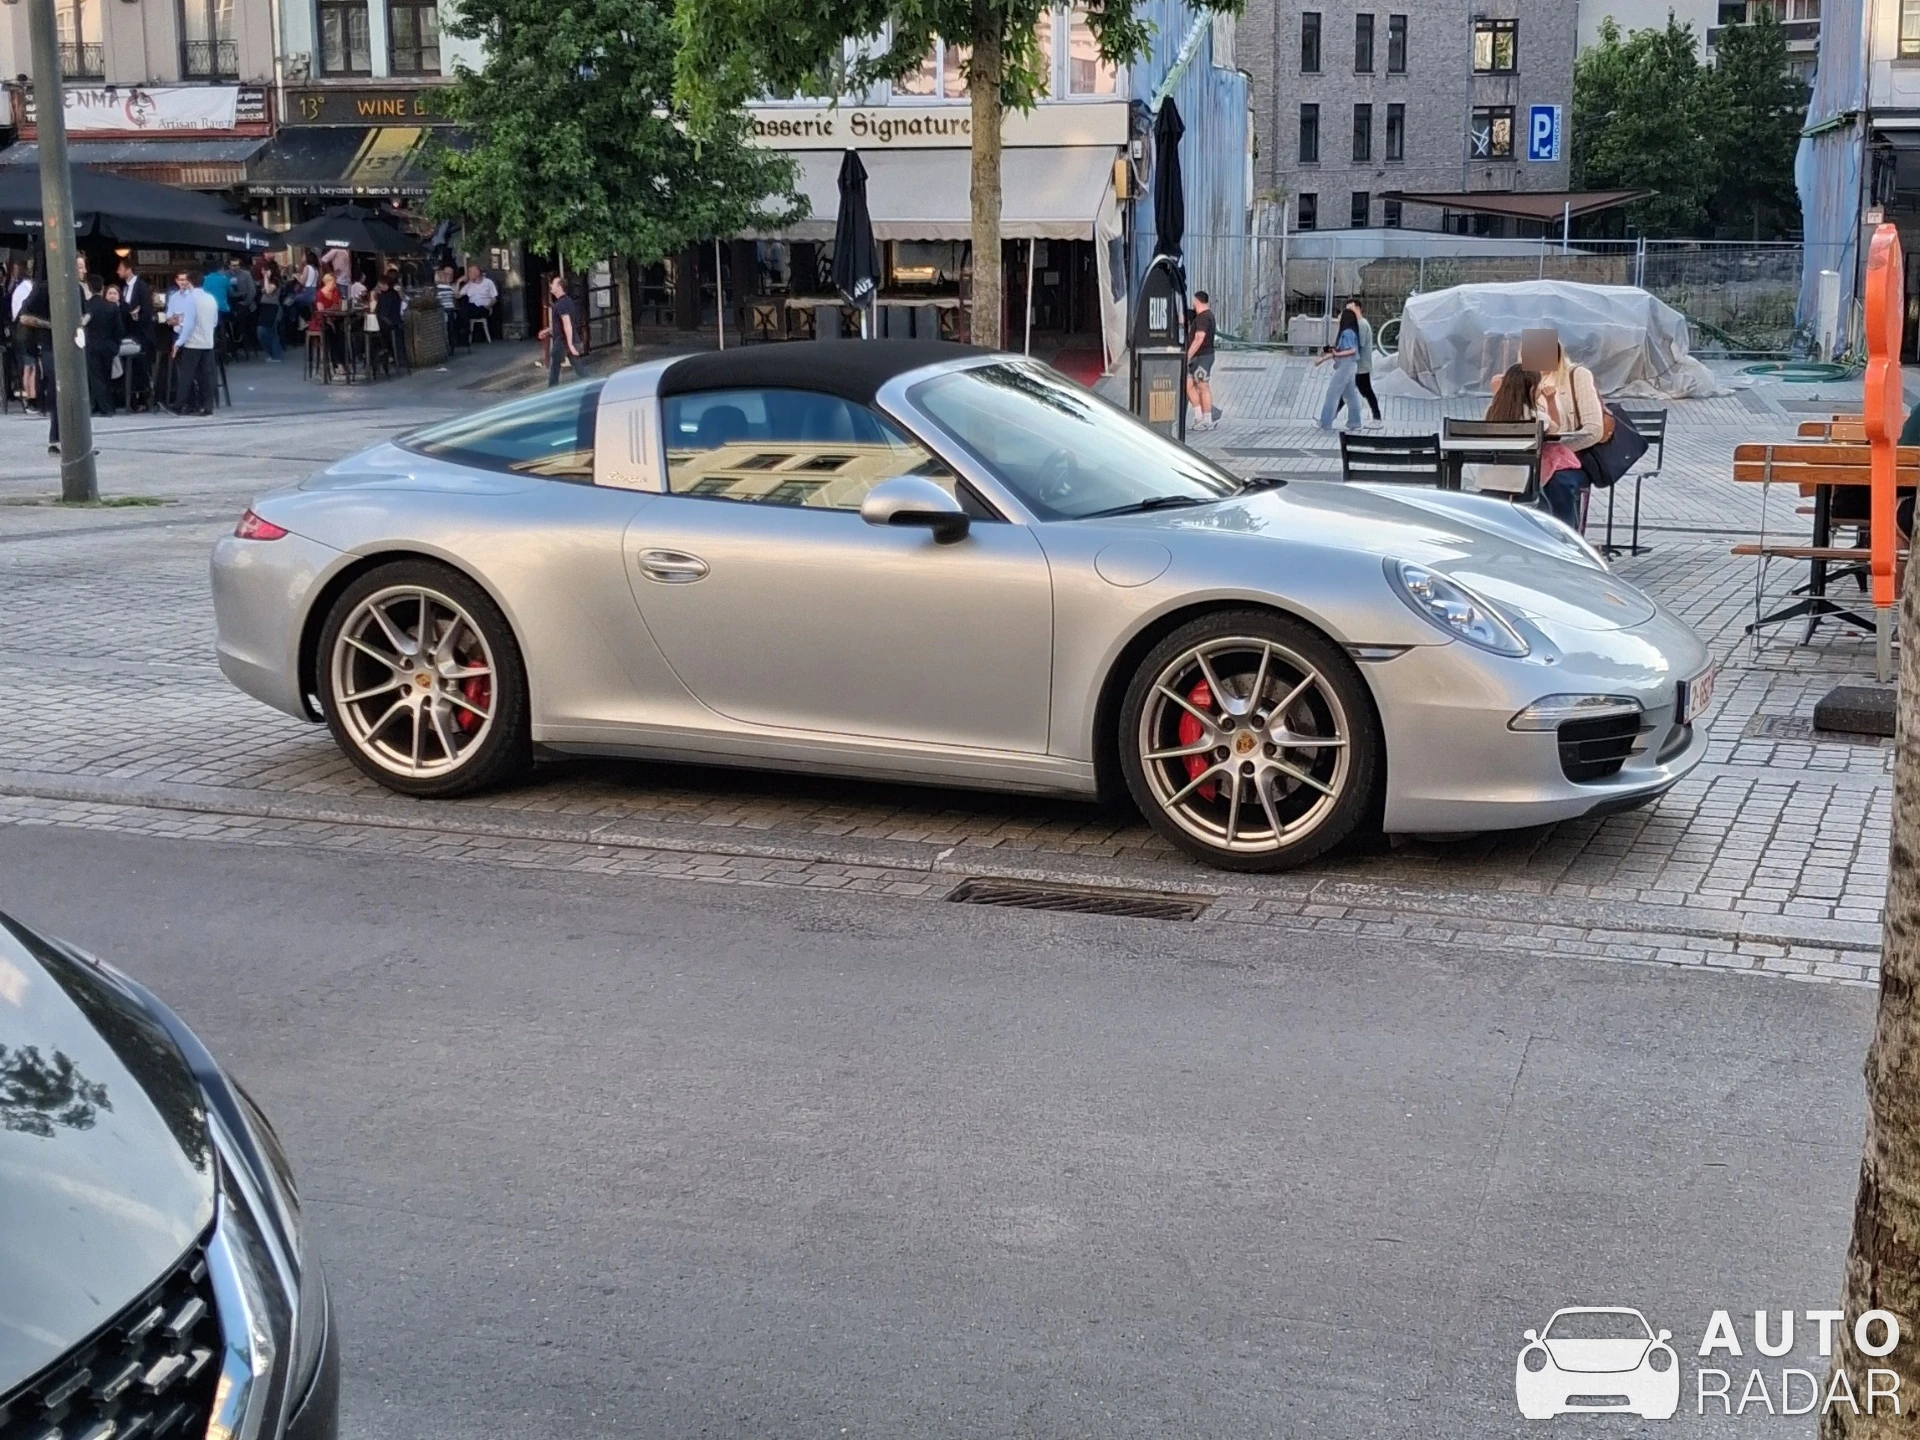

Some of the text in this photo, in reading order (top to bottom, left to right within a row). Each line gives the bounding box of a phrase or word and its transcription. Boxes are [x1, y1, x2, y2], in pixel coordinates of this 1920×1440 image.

[63, 90, 121, 109] ENMA
[299, 96, 325, 120] 13°
[357, 99, 406, 116] WINE
[158, 117, 235, 130] Artisan Ramn
[753, 112, 971, 142] asserie Signature
[1533, 114, 1551, 152] P
[276, 185, 308, 195] cheese
[319, 185, 354, 196] beyond
[366, 185, 391, 195] lunch
[401, 186, 424, 195] after
[1149, 297, 1168, 330] ELLIS
